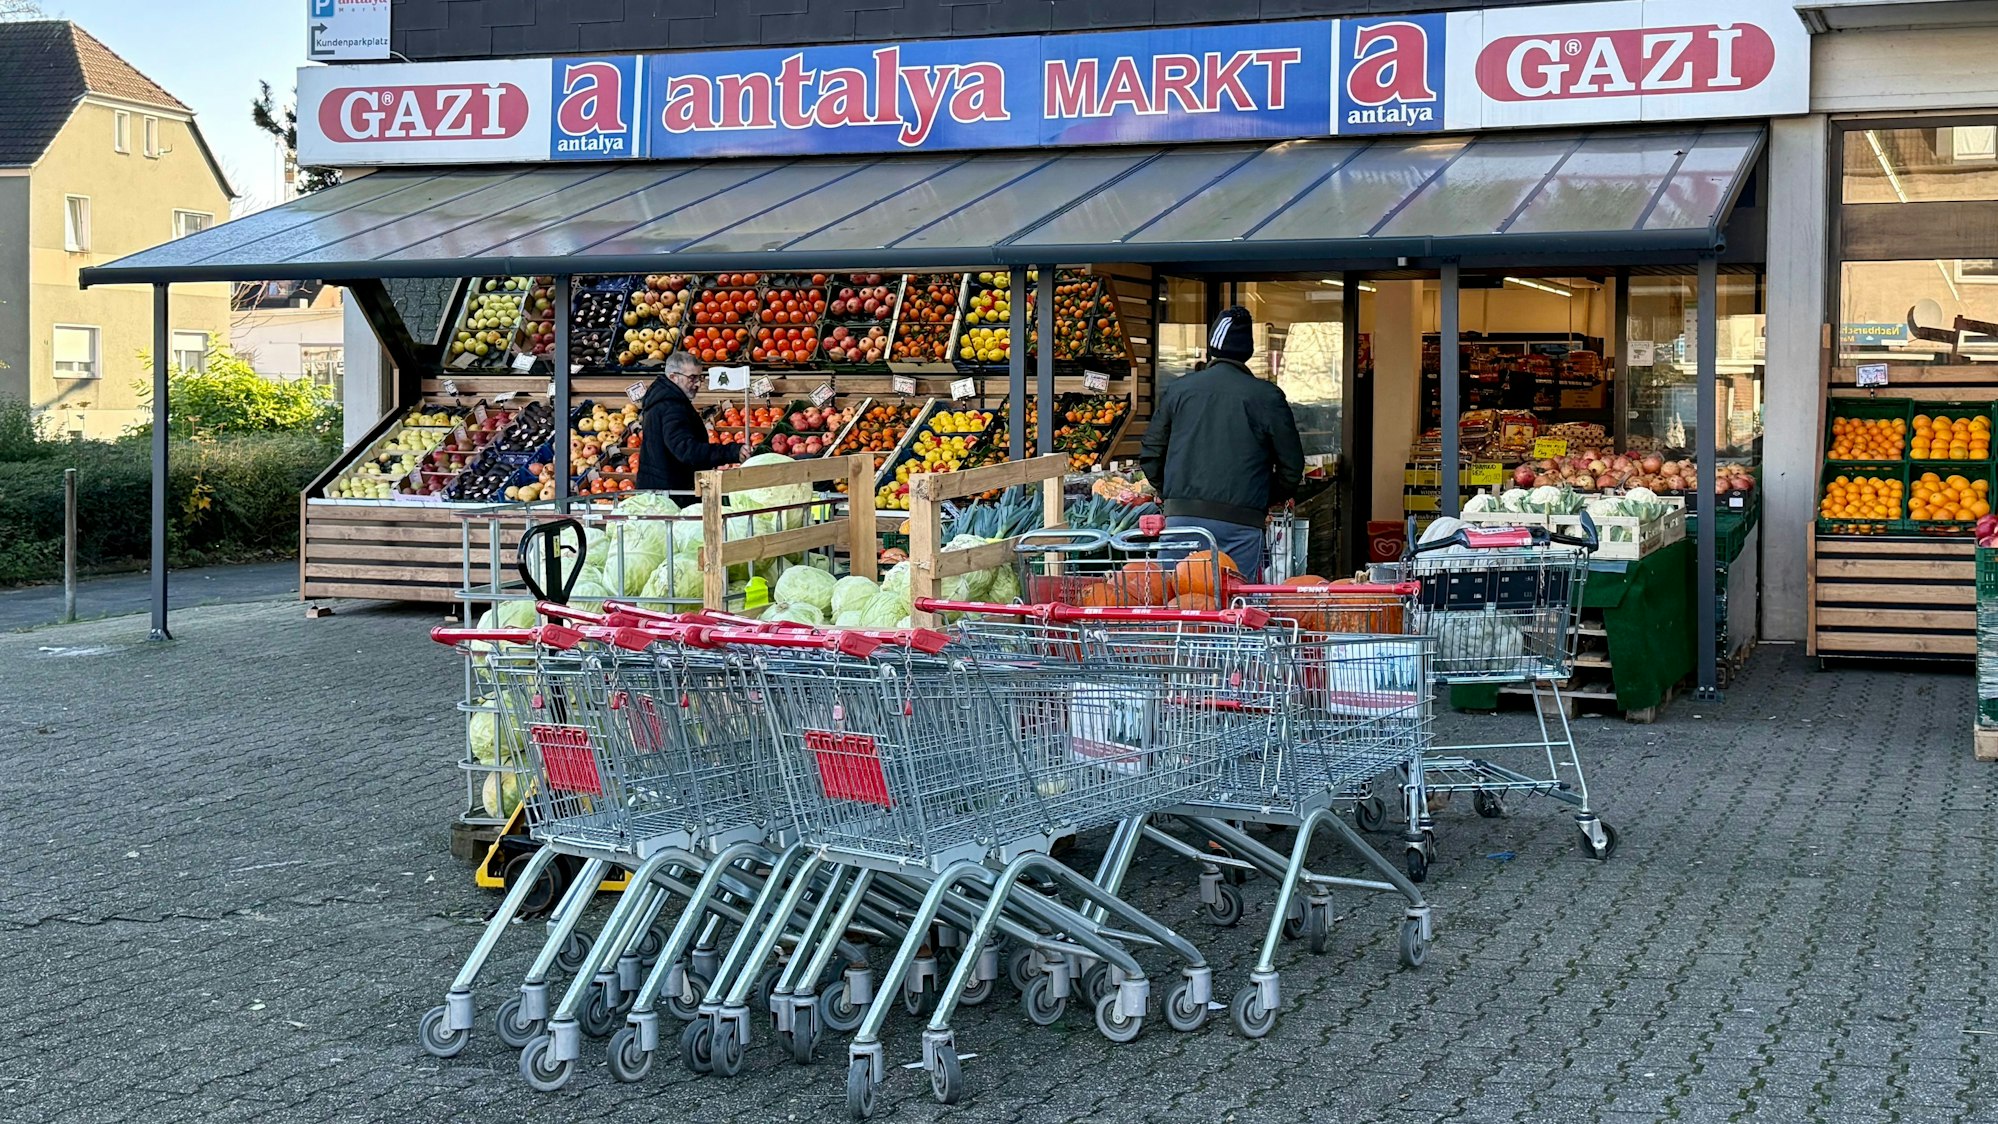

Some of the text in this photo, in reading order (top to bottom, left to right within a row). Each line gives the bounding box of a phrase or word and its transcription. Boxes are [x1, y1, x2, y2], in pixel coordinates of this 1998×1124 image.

[316, 37, 389, 47] Kundenparkplatz
[1346, 21, 1437, 107] a
[557, 61, 628, 136] a
[661, 46, 1302, 147] antalya MARKT
[1347, 104, 1433, 127] antalya
[557, 134, 624, 155] antalya
